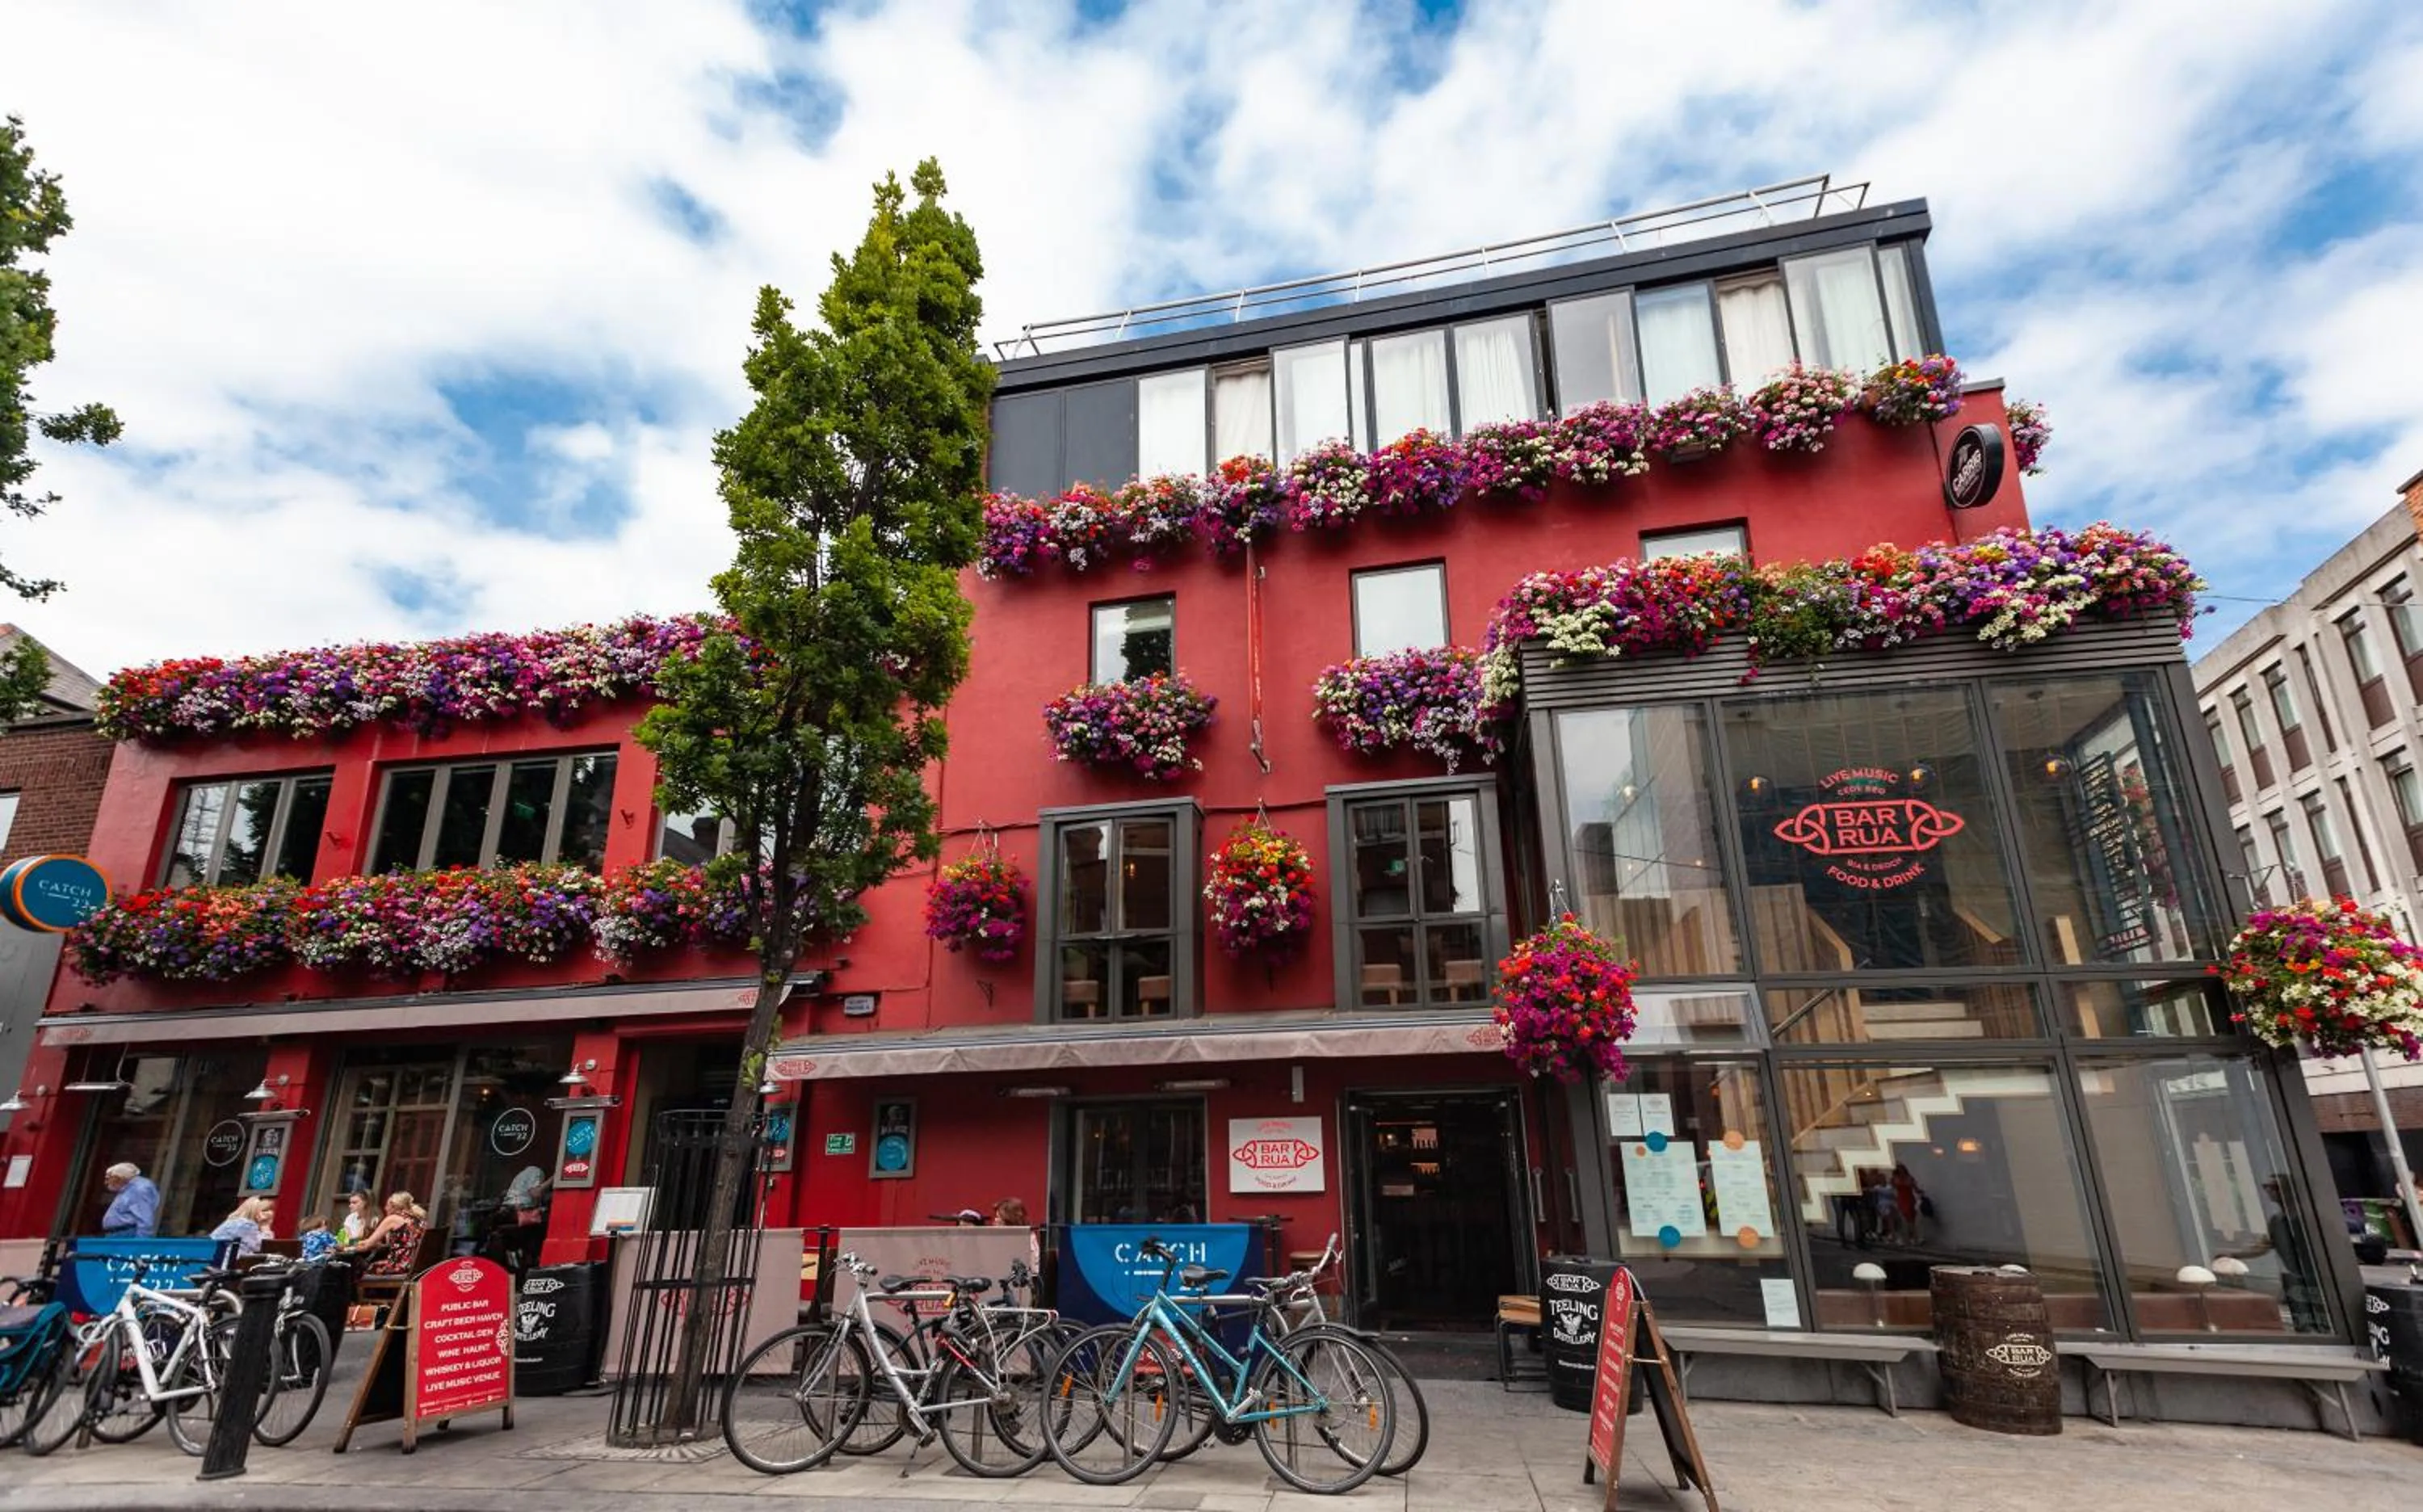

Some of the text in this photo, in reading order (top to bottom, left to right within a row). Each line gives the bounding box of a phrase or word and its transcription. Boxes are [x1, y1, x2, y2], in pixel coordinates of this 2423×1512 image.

[1820, 768, 1899, 788] LIVE MUSIC
[1834, 808, 1898, 827] BAR
[1837, 827, 1902, 846] RUA
[1827, 862, 1925, 889] FOOD & DRINK
[38, 880, 91, 897] CATCH
[498, 1124, 529, 1132] CATCH
[1261, 1144, 1290, 1154] BAR
[1261, 1154, 1290, 1164] RUA
[440, 1300, 489, 1312] PUBLIC BAR
[1548, 1298, 1598, 1321] TEELING
[424, 1312, 503, 1329] CRAFT BEER HAVEN
[435, 1329, 493, 1343] COCKTAIL DEN
[1553, 1327, 1596, 1344] DISTILLERY
[438, 1343, 490, 1359] WINE HAUNT
[425, 1357, 502, 1376] WHISKEY & LIQUOR
[425, 1371, 501, 1393] LIVE MUSIC VENUE
